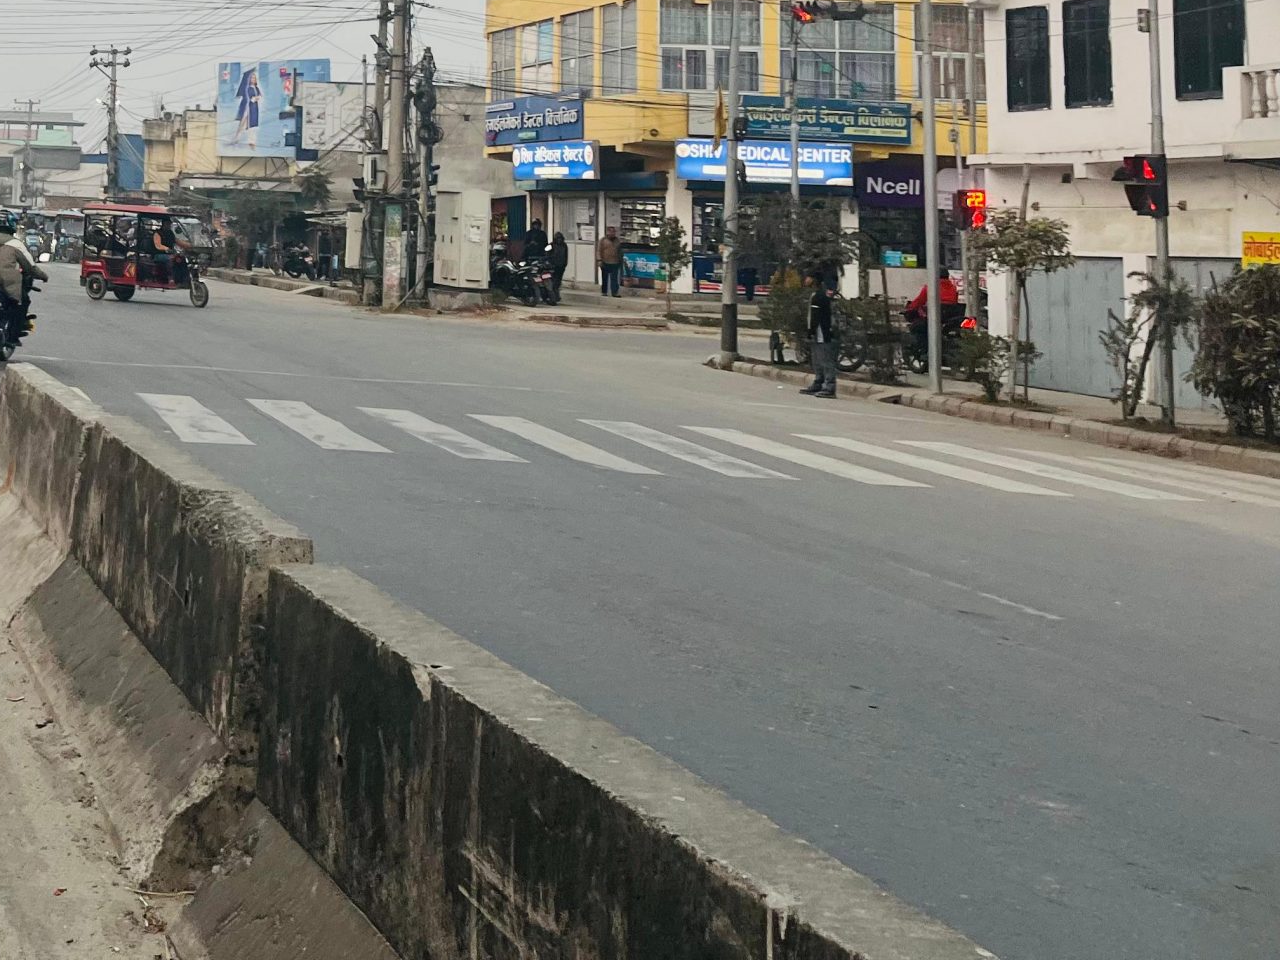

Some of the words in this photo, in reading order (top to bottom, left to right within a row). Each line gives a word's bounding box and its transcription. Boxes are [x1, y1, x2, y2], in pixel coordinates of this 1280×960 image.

[737, 146, 791, 161] EDICAL
[866, 176, 921, 196] Ncell
[966, 192, 984, 208] 22
